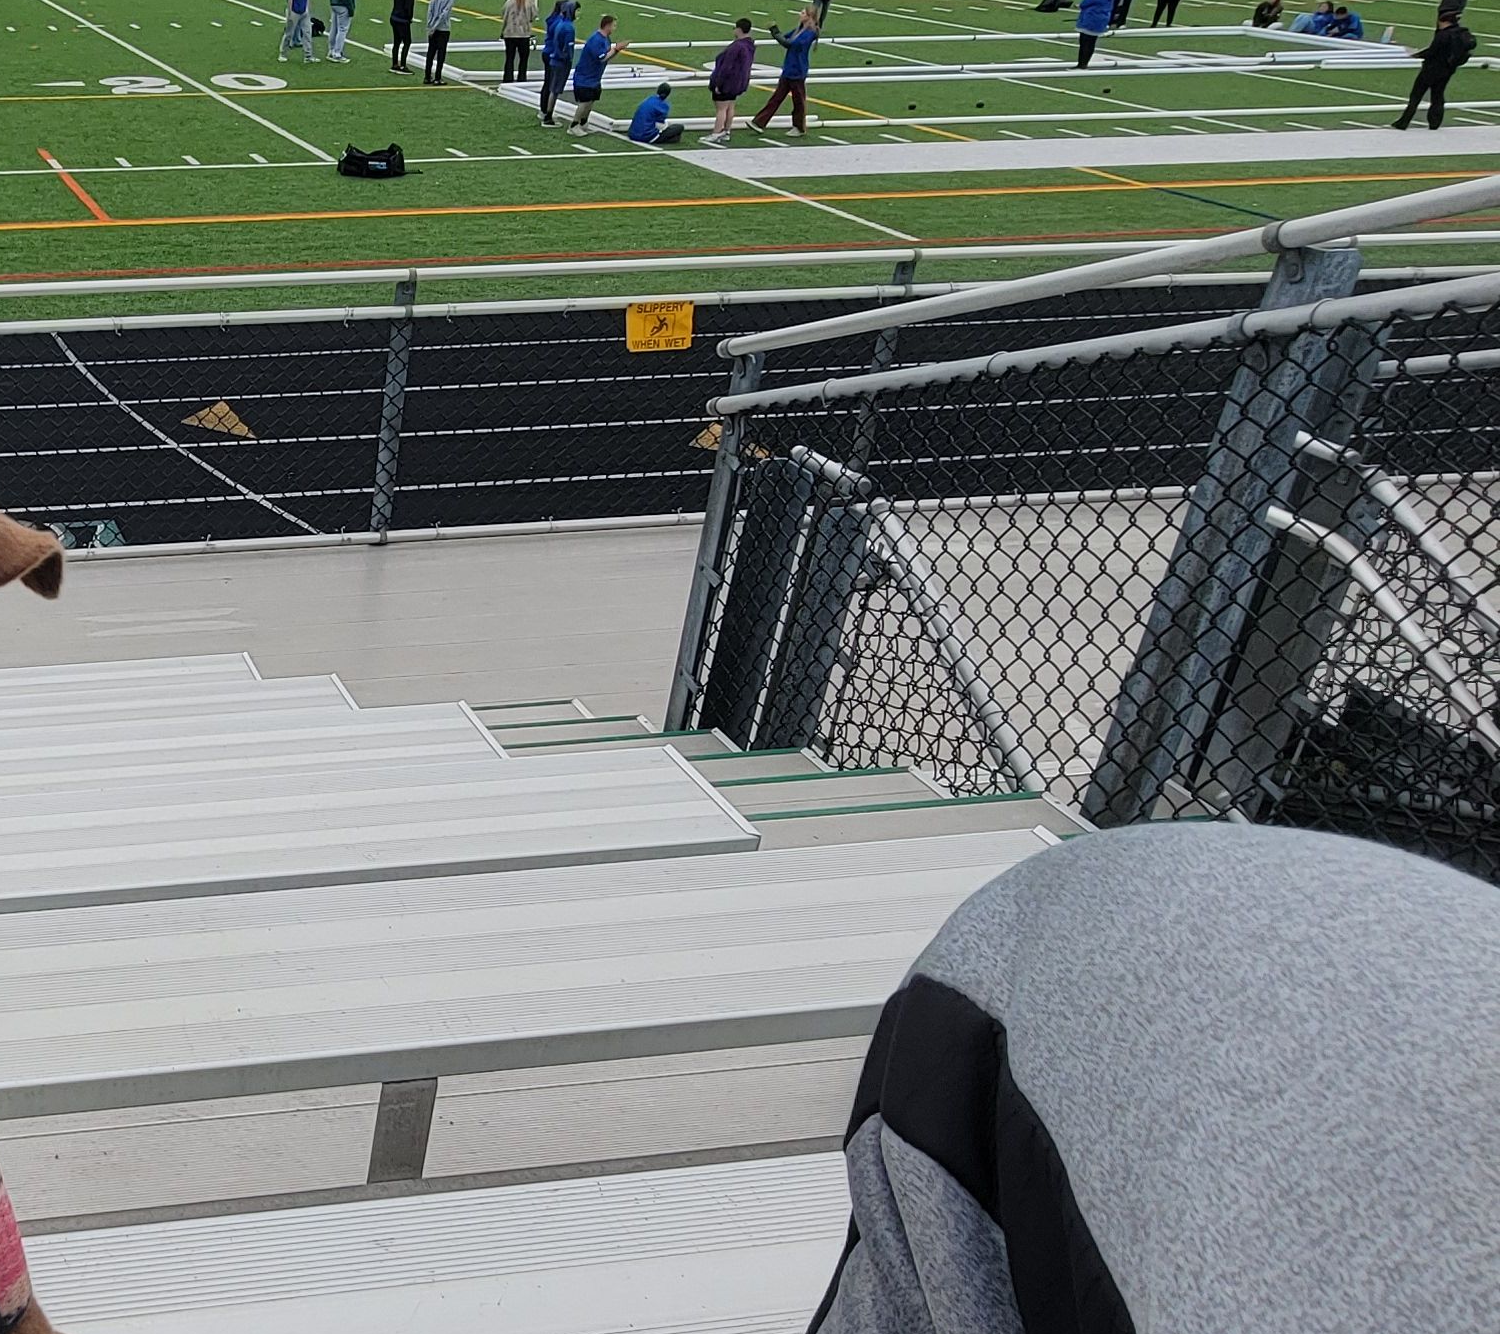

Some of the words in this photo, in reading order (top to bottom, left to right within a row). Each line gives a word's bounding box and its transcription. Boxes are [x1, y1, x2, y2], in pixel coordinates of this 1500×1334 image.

[636, 301, 685, 314] SLIPPERY
[631, 338, 660, 350] WHEN
[664, 337, 687, 348] WET
